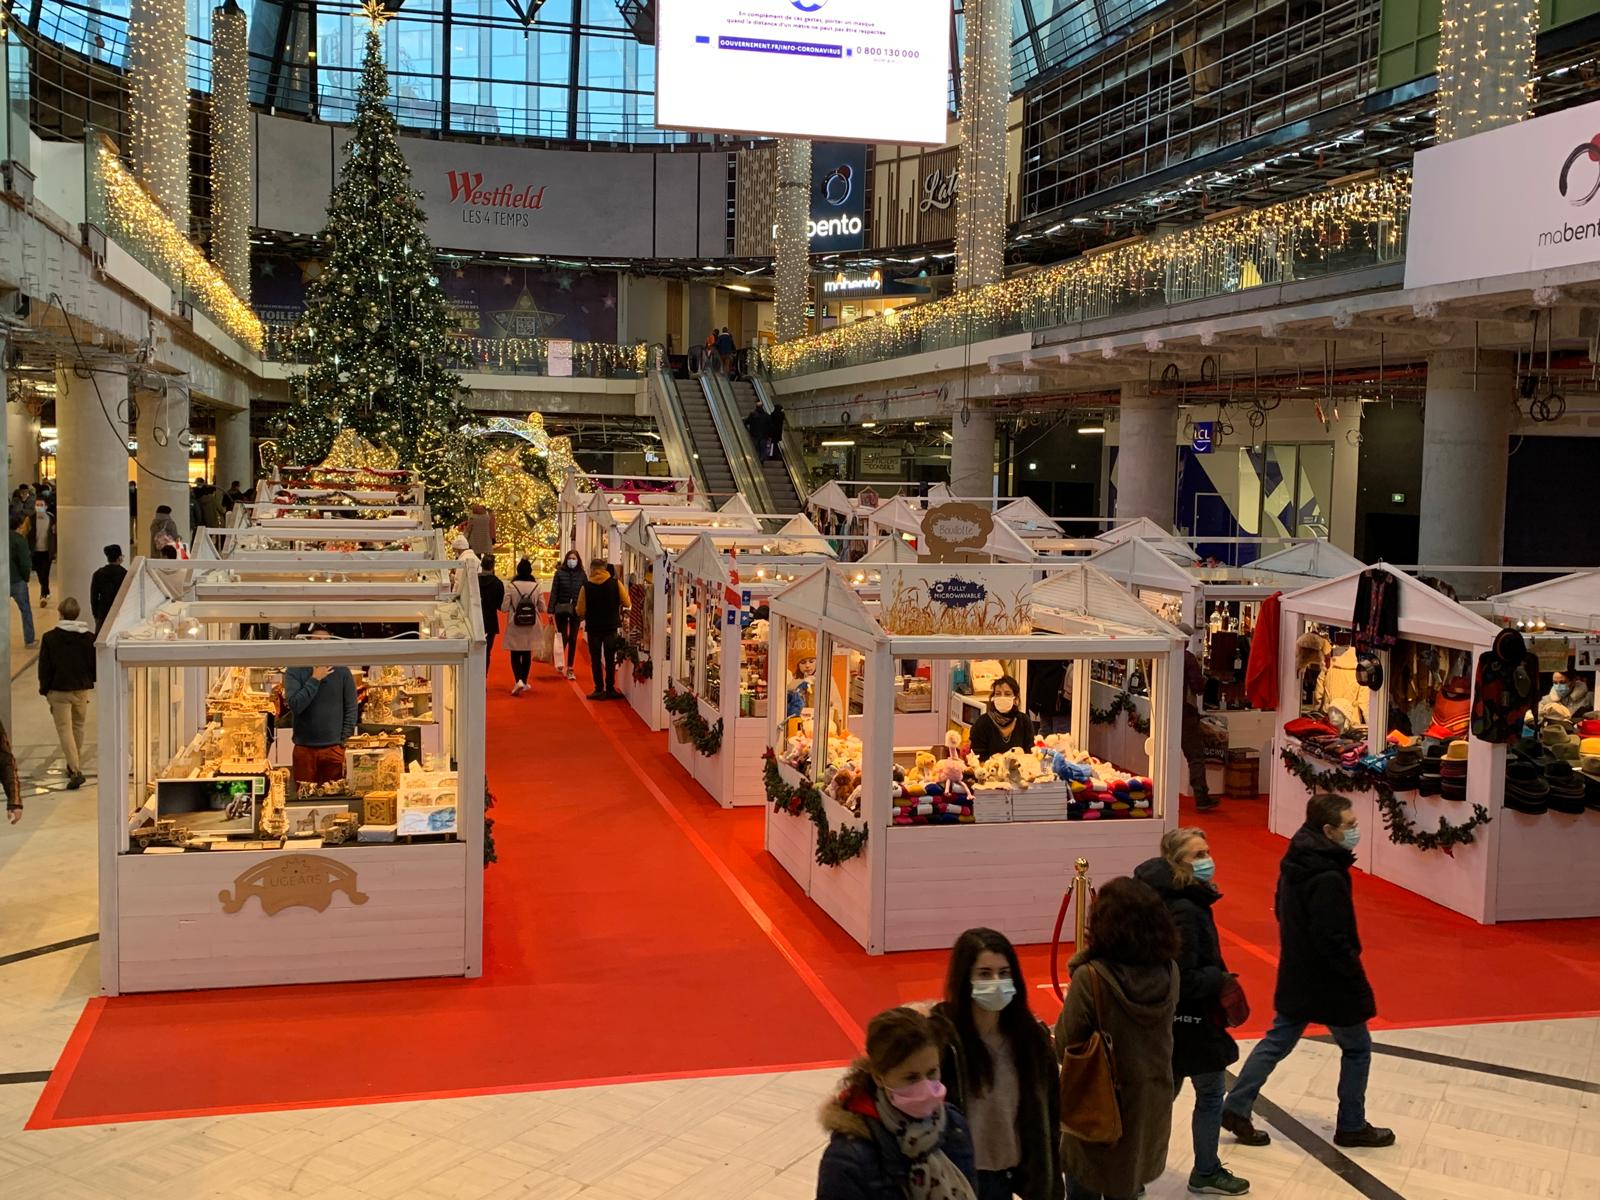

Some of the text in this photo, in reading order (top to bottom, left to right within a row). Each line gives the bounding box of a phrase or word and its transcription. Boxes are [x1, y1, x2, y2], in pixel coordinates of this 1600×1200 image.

[720, 39, 841, 55] GOUVERNEMENT.FR/INFO-CORONAVIRUS
[864, 47, 882, 56] 800
[884, 48, 900, 57] 130
[901, 50, 920, 59] 000
[444, 169, 549, 210] Westfield
[462, 209, 530, 228] LES 4 TEMPS
[1194, 429, 1211, 440] LCL
